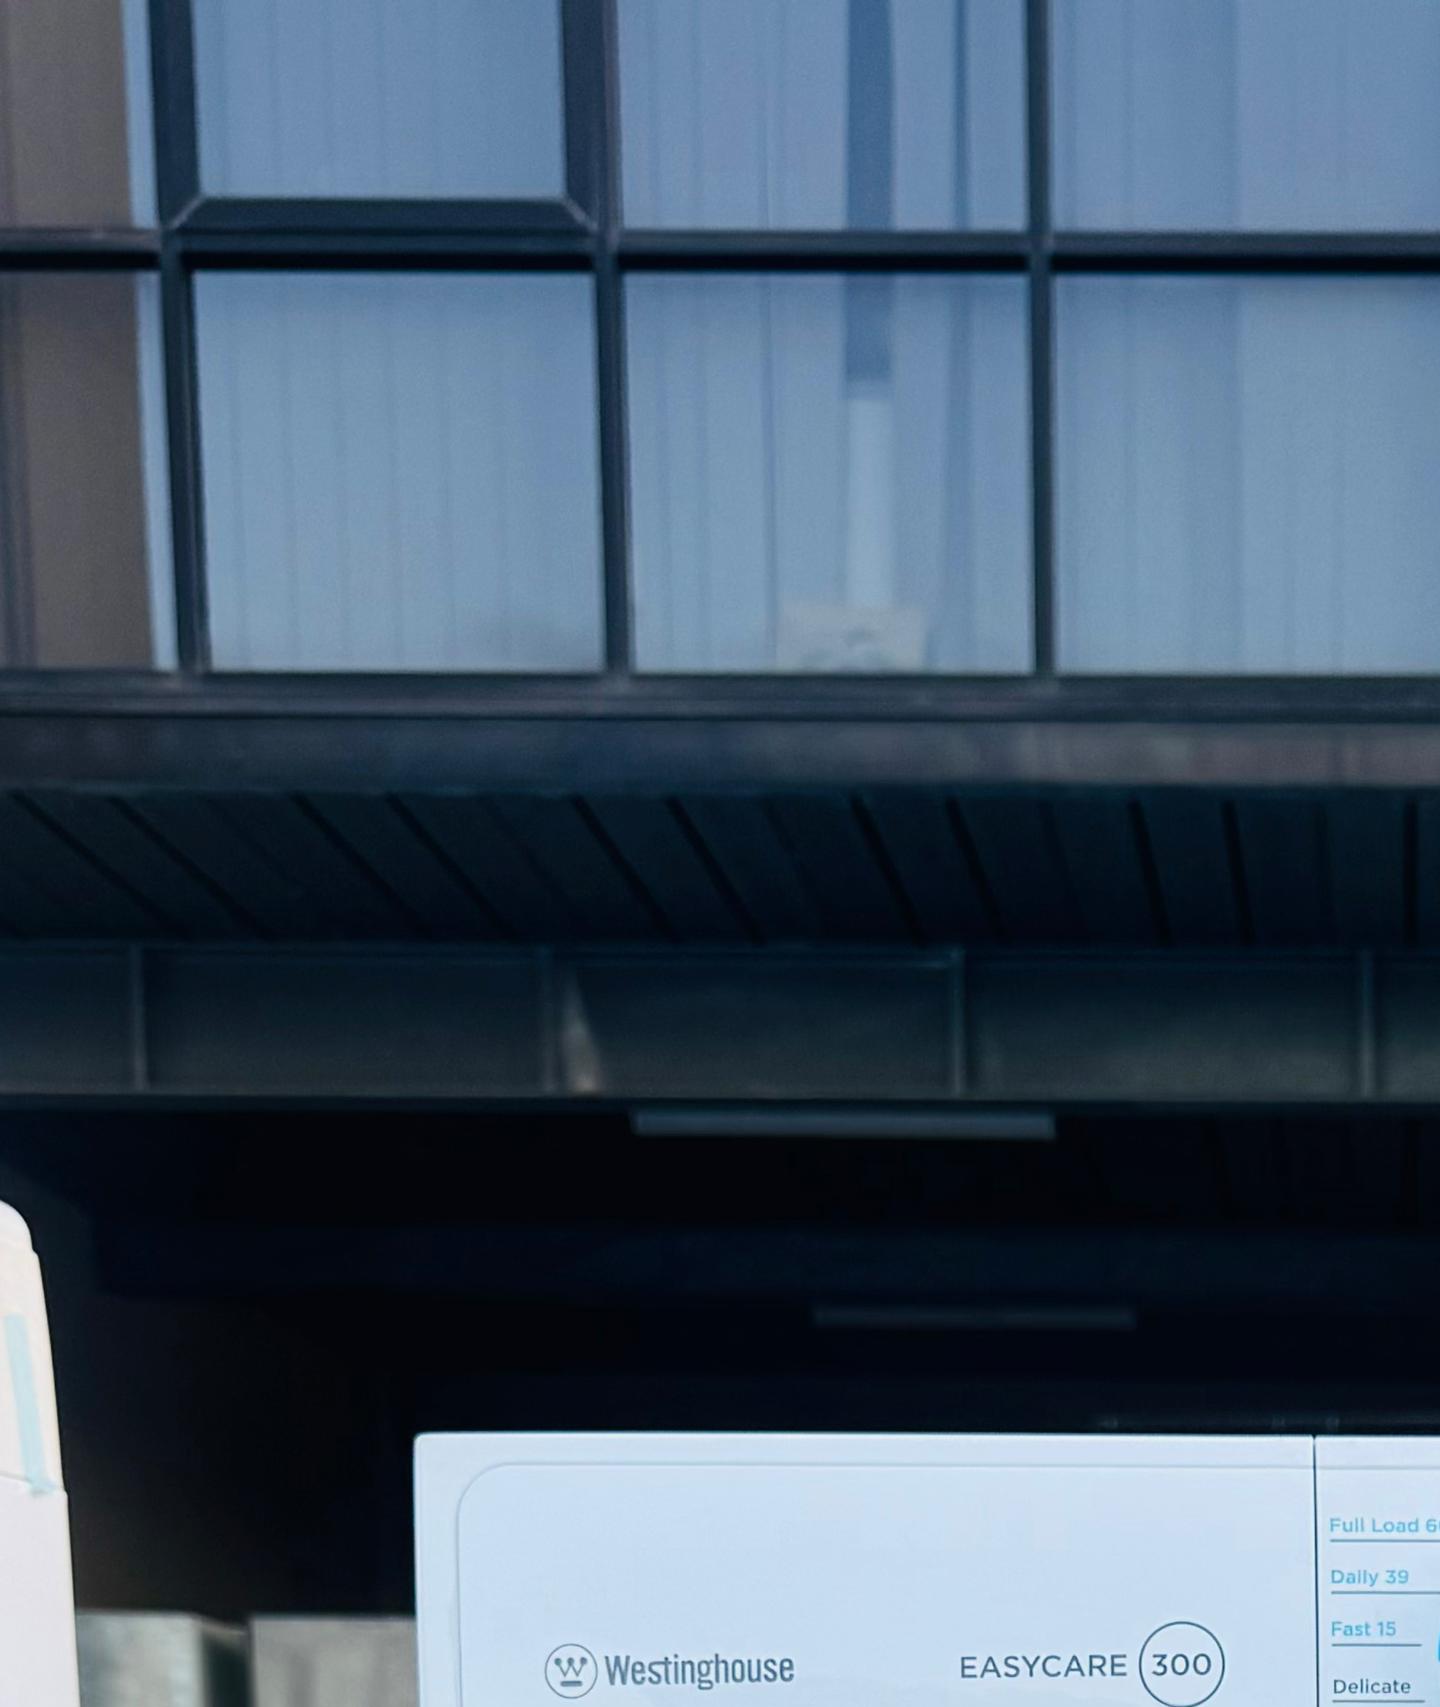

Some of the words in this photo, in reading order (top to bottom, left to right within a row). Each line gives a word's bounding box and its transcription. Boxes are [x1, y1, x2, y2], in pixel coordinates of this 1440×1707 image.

[1329, 1517, 1365, 1534] Full
[1371, 1517, 1420, 1534] Load
[1330, 1569, 1380, 1588] Daily
[1384, 1569, 1410, 1585] 39
[1331, 1620, 1372, 1637] Fast
[1376, 1620, 1397, 1637] 15
[603, 1652, 796, 1691] Westinghouse
[959, 1652, 1129, 1680] EASYCARE
[1150, 1652, 1213, 1677] 300
[1333, 1678, 1412, 1695] Delicate
